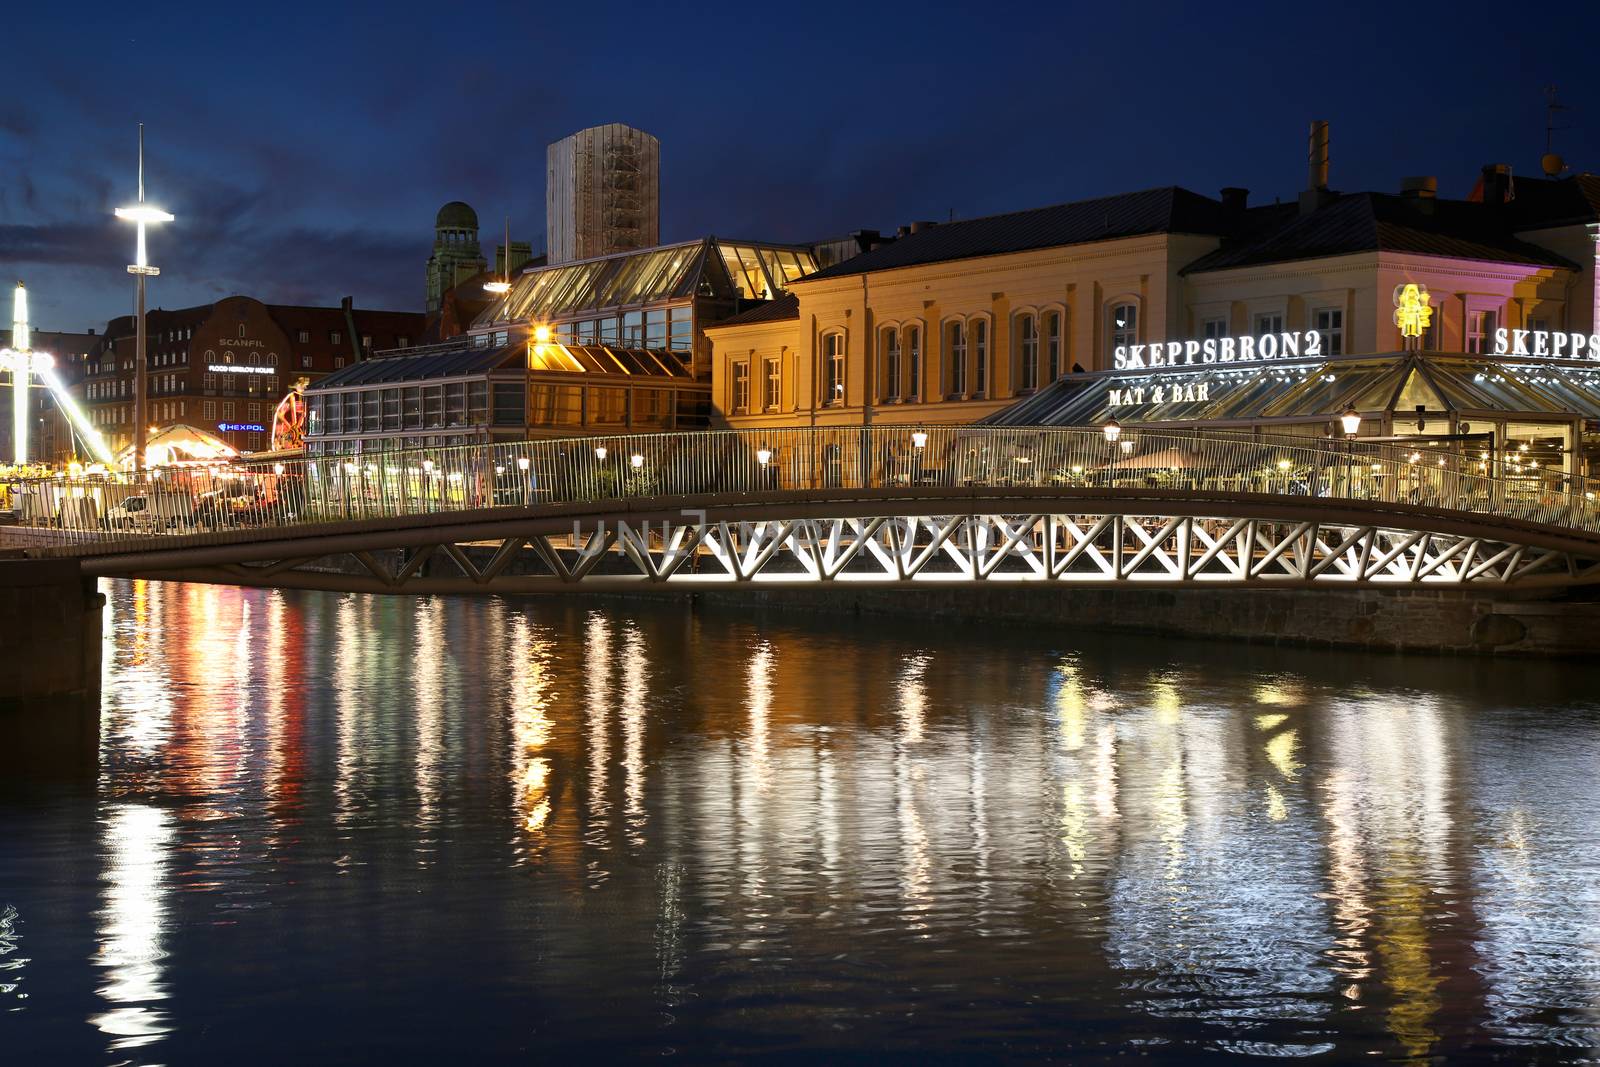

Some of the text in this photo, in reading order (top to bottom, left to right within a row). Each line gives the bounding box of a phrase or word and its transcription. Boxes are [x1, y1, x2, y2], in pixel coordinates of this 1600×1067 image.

[219, 338, 265, 347] SCANFIL
[1109, 384, 1209, 406] MAT & BAR
